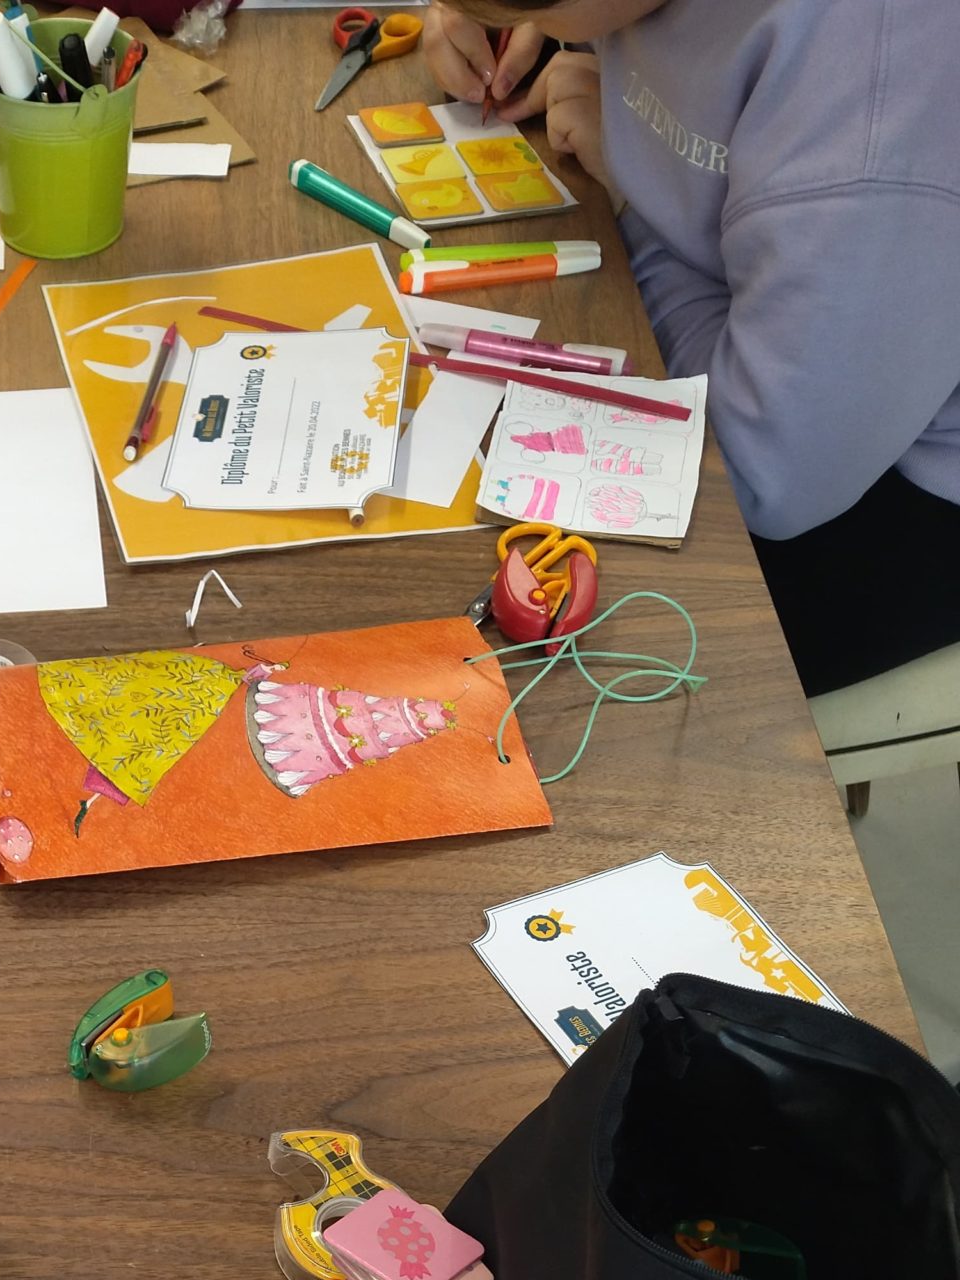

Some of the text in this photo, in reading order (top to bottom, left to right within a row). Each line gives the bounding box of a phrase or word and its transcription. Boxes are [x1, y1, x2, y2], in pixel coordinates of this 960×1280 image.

[622, 71, 728, 174] LAVENDER
[221, 368, 265, 485] Diplôme du Petit Valoriste
[331, 1139, 346, 1158] 3M
